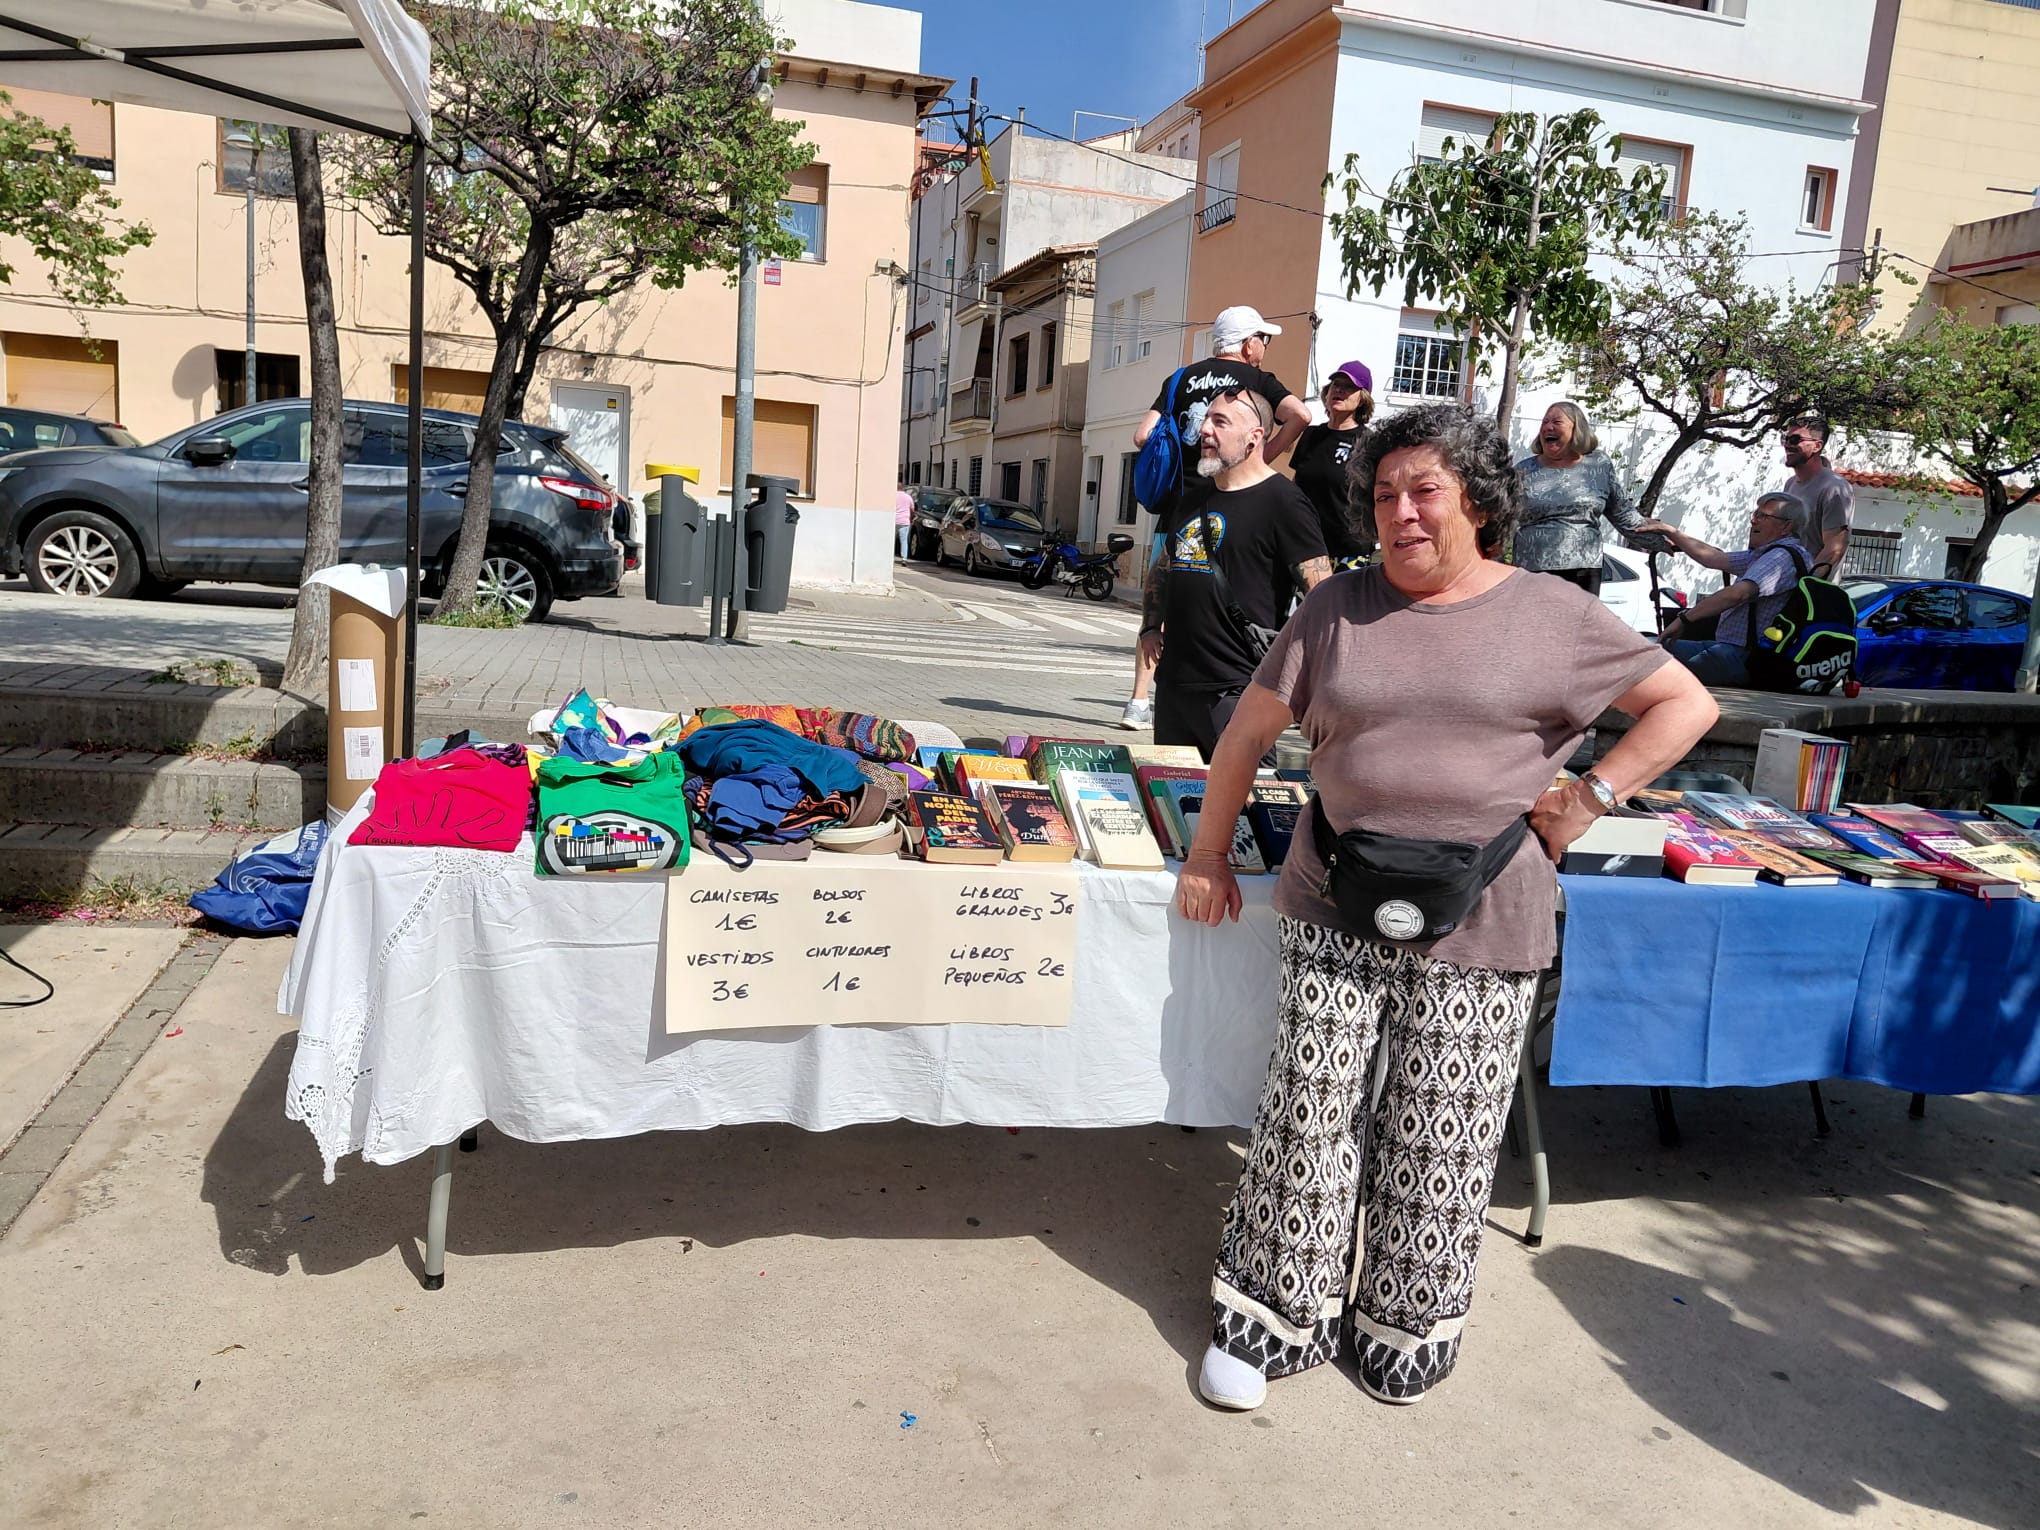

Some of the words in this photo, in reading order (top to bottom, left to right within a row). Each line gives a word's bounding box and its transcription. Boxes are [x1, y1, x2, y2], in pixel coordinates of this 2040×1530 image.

[583, 366, 595, 378] 27
[1796, 650, 1852, 679] arena
[1053, 745, 1093, 760] JEAN
[1098, 748, 1115, 761] M
[924, 801, 980, 814] NOMBRE
[932, 796, 949, 804] EN
[953, 798, 968, 806] EL
[935, 815, 977, 824] PADRE
[942, 809, 967, 817] DEL
[690, 889, 779, 905] CAMISETAS
[813, 889, 867, 902] BOLSOS
[960, 886, 1024, 901] LIBROS
[955, 904, 1043, 921] GRANDES
[1049, 891, 1075, 916] 3€
[714, 913, 757, 931] 1€
[825, 910, 852, 924] 2€
[686, 949, 774, 967] VESTIDOS
[950, 944, 1015, 962] LIBROS
[944, 967, 1027, 987] PEQUEÑOS
[1037, 957, 1065, 977] 2€
[711, 980, 749, 1001] 3€
